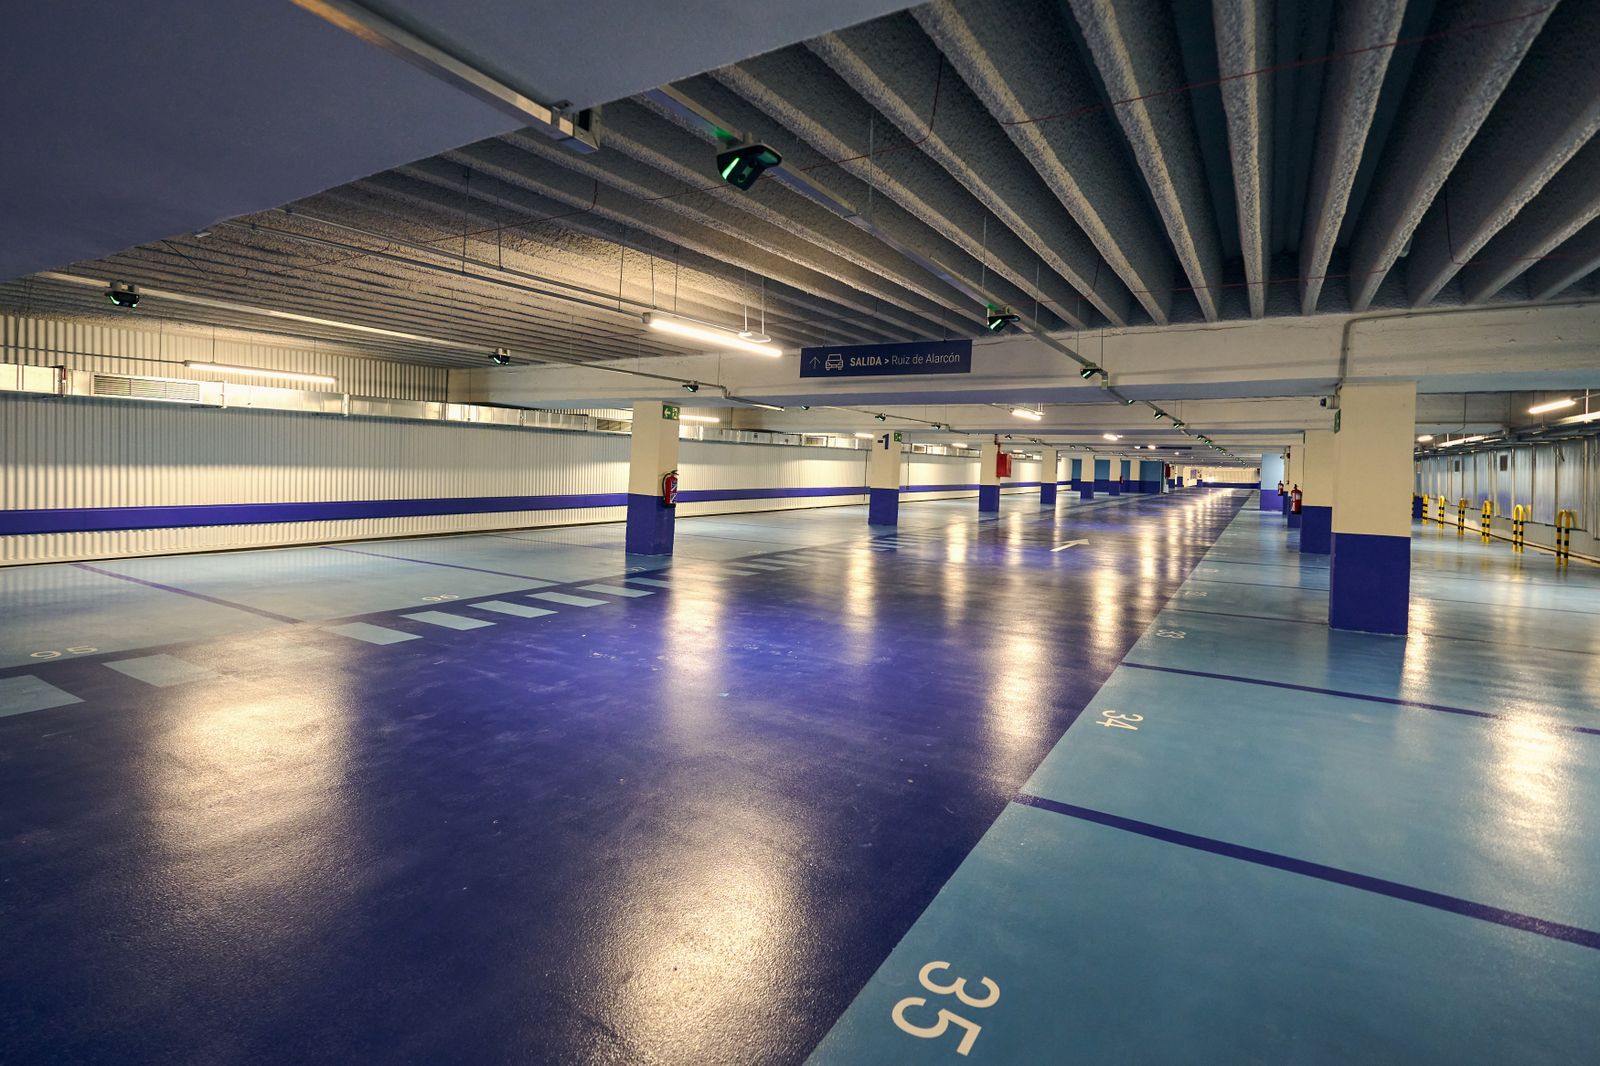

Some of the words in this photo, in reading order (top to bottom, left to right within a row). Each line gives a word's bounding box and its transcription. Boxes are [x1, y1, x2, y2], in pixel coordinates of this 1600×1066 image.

[850, 356, 882, 367] SALIDA
[891, 354, 910, 365] Ruiz
[912, 354, 924, 364] de
[925, 352, 960, 364] Alarcón
[877, 433, 890, 450] -1
[30, 645, 99, 660] 95
[1095, 709, 1144, 731] 34
[891, 960, 1001, 1057] 35
